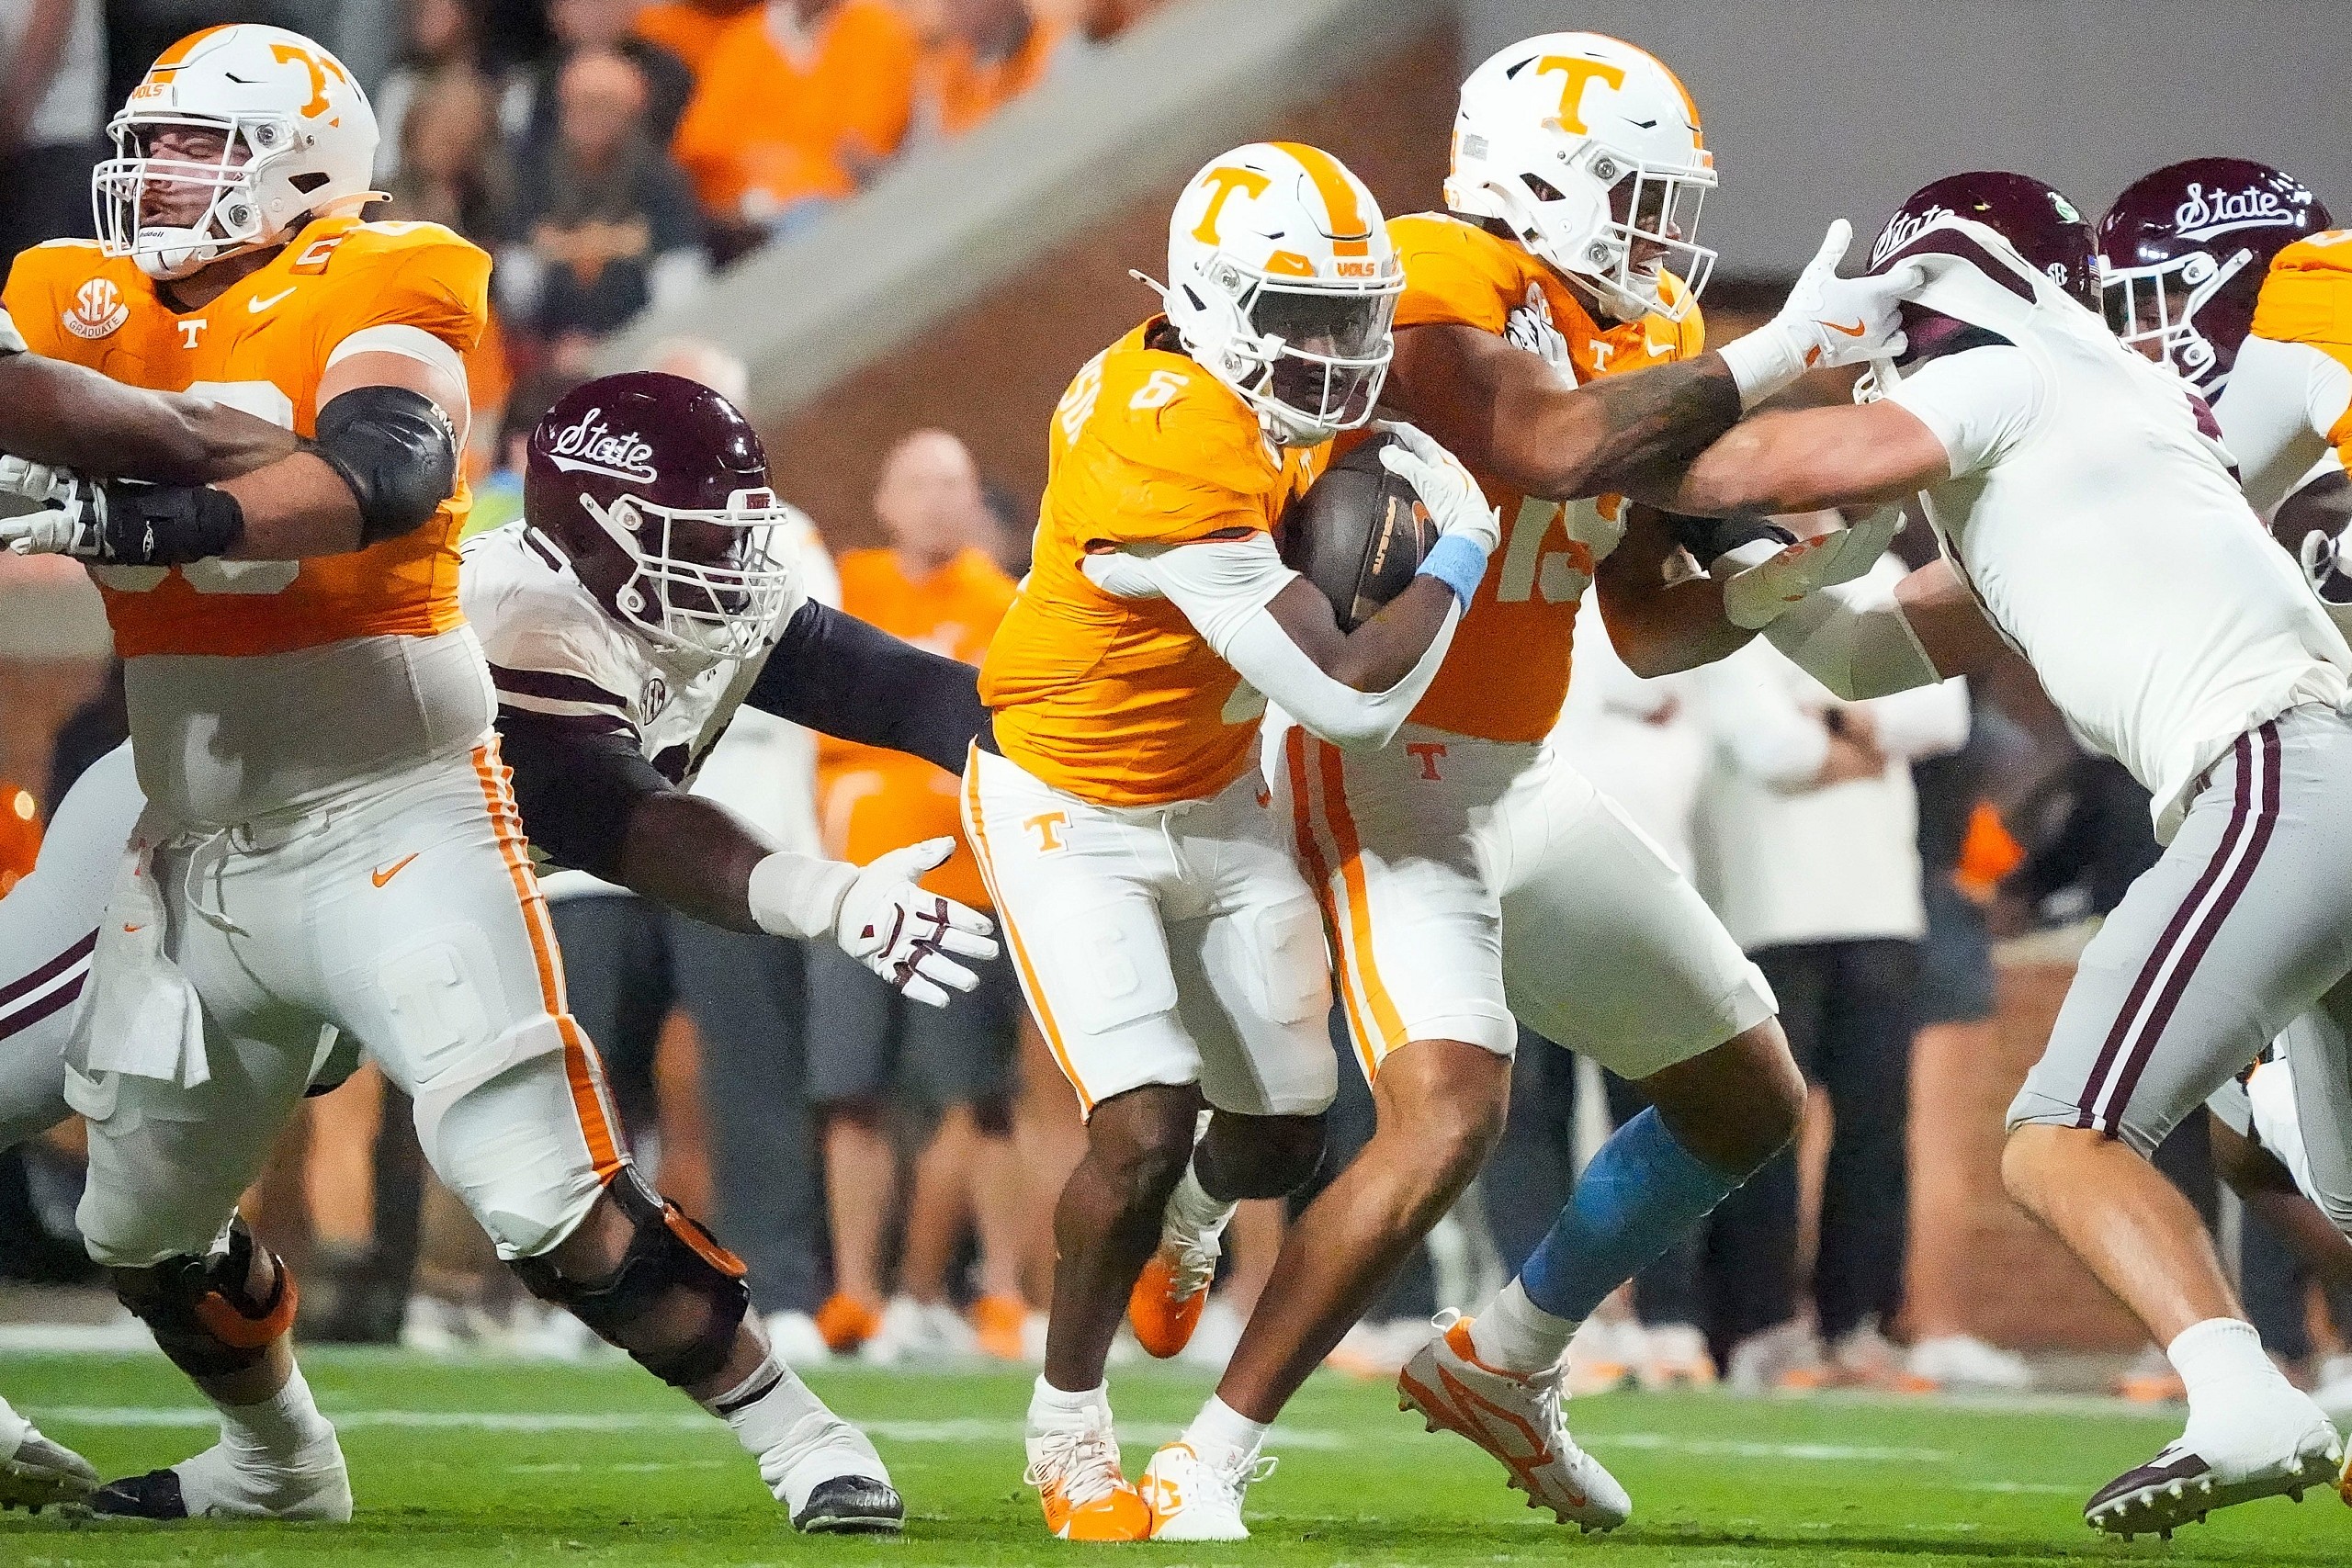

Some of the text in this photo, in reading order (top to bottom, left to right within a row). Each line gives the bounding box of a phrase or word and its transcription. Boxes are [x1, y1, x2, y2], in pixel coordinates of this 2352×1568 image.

[269, 44, 345, 128] T
[1536, 55, 1626, 135] T
[1192, 167, 1272, 246] T
[2176, 183, 2294, 242] State
[1337, 262, 1375, 277] VOLS
[77, 278, 119, 321] SEC
[69, 316, 120, 337] GRADUATE
[177, 319, 207, 349] T
[1589, 340, 1614, 371] T
[1128, 370, 1190, 411] 6
[548, 407, 658, 484] State
[1407, 742, 1447, 781] T
[1023, 811, 1068, 852] T
